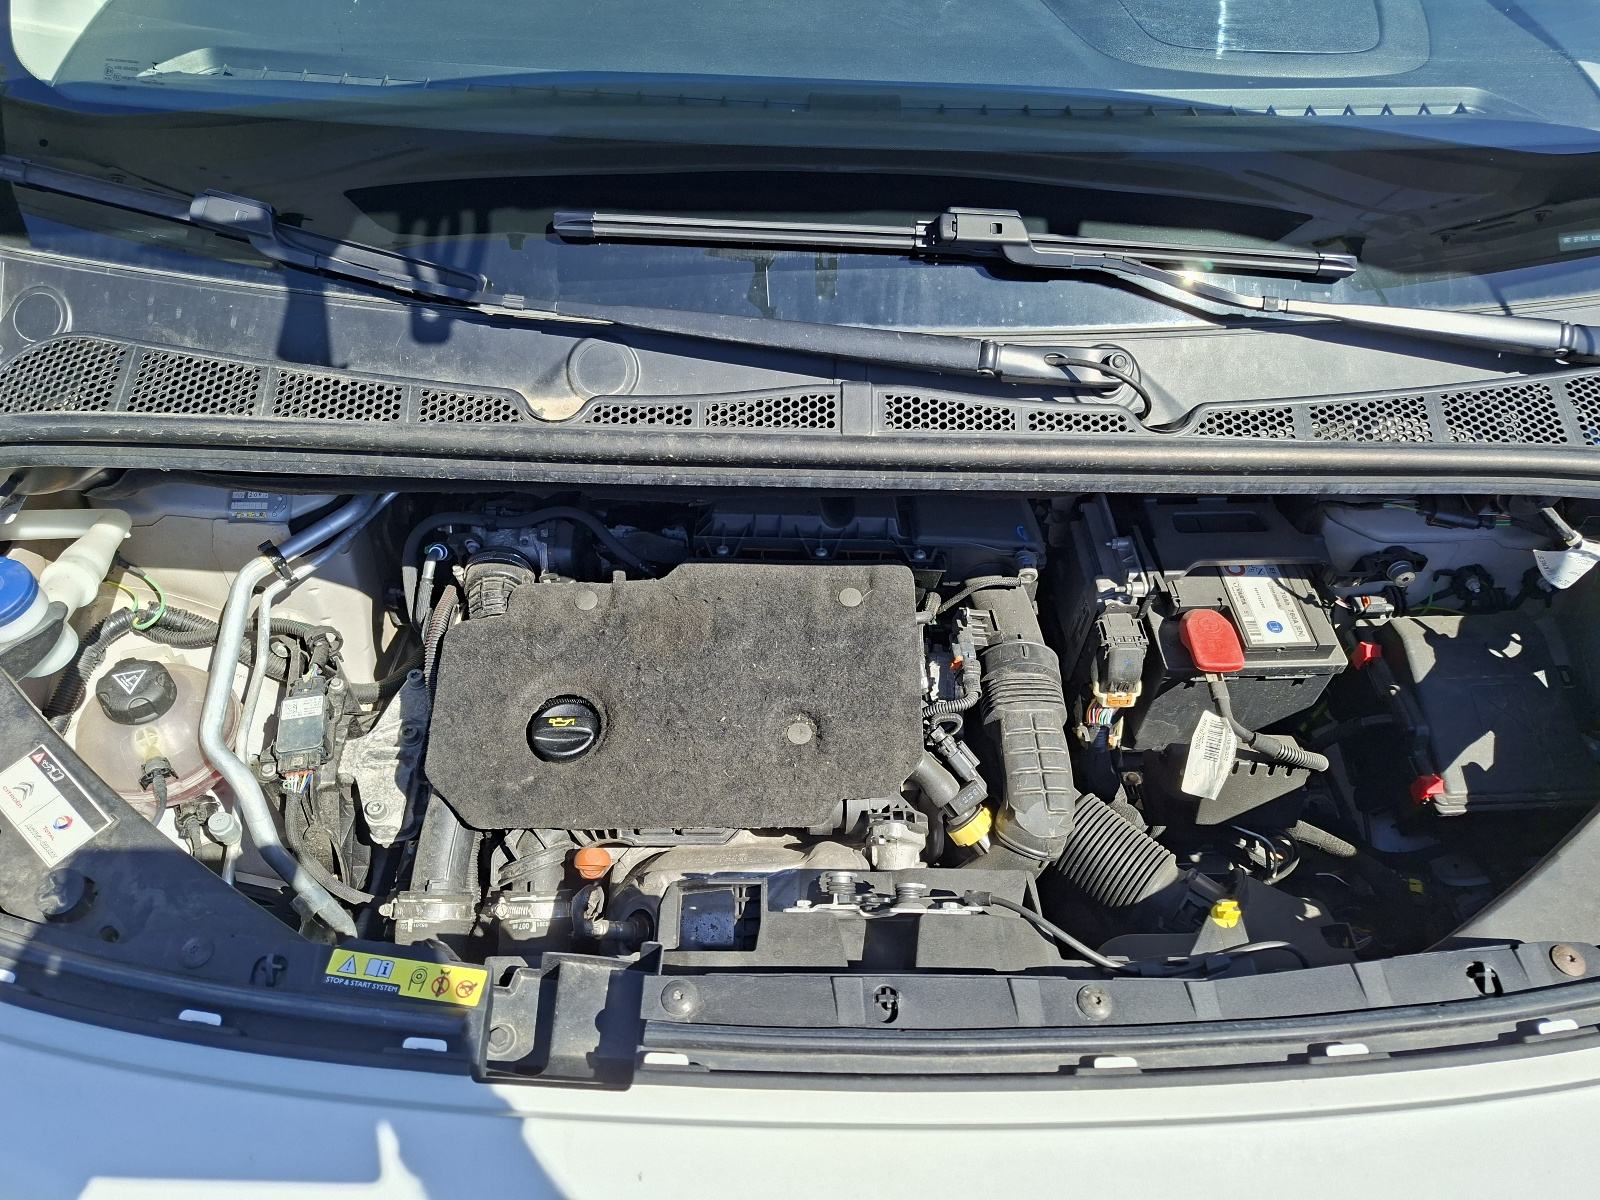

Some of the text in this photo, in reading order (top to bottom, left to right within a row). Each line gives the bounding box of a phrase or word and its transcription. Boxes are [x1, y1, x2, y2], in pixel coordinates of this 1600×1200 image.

[325, 976, 344, 984] STOP
[350, 980, 372, 988] START
[371, 984, 398, 992] SYSTEM
